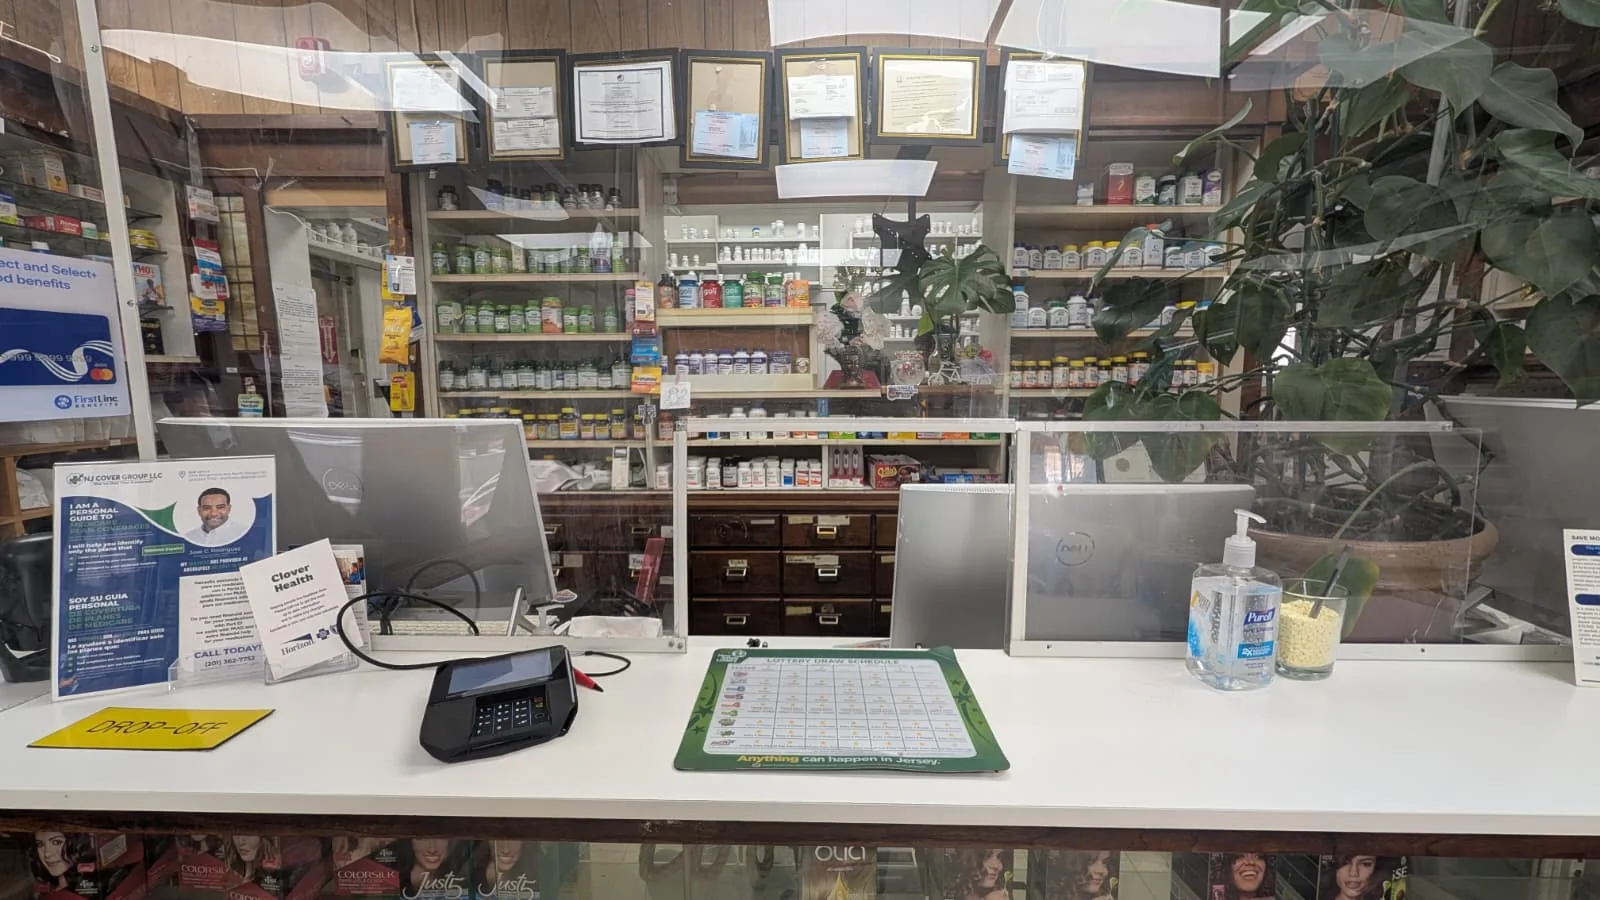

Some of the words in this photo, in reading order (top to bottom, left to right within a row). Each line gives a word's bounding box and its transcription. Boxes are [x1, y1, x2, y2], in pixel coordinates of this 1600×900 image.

[24, 262, 48, 273] and
[51, 264, 96, 278] Select+
[16, 274, 72, 290] benefits
[704, 287, 716, 296] goli
[74, 394, 119, 404] FirstLine
[70, 508, 119, 516] PERSONAL
[272, 564, 310, 583] Clover
[274, 574, 314, 592] Health
[69, 601, 120, 610] PERSONAL
[1248, 611, 1273, 622] Purell
[194, 650, 221, 659] CALL
[224, 644, 261, 655] TODAY!
[281, 638, 314, 656] Horizon
[88, 720, 228, 734] DROP-OFF
[737, 755, 799, 765] Anything
[896, 757, 941, 766] Jersey.
[338, 871, 396, 880] COLORSILK
